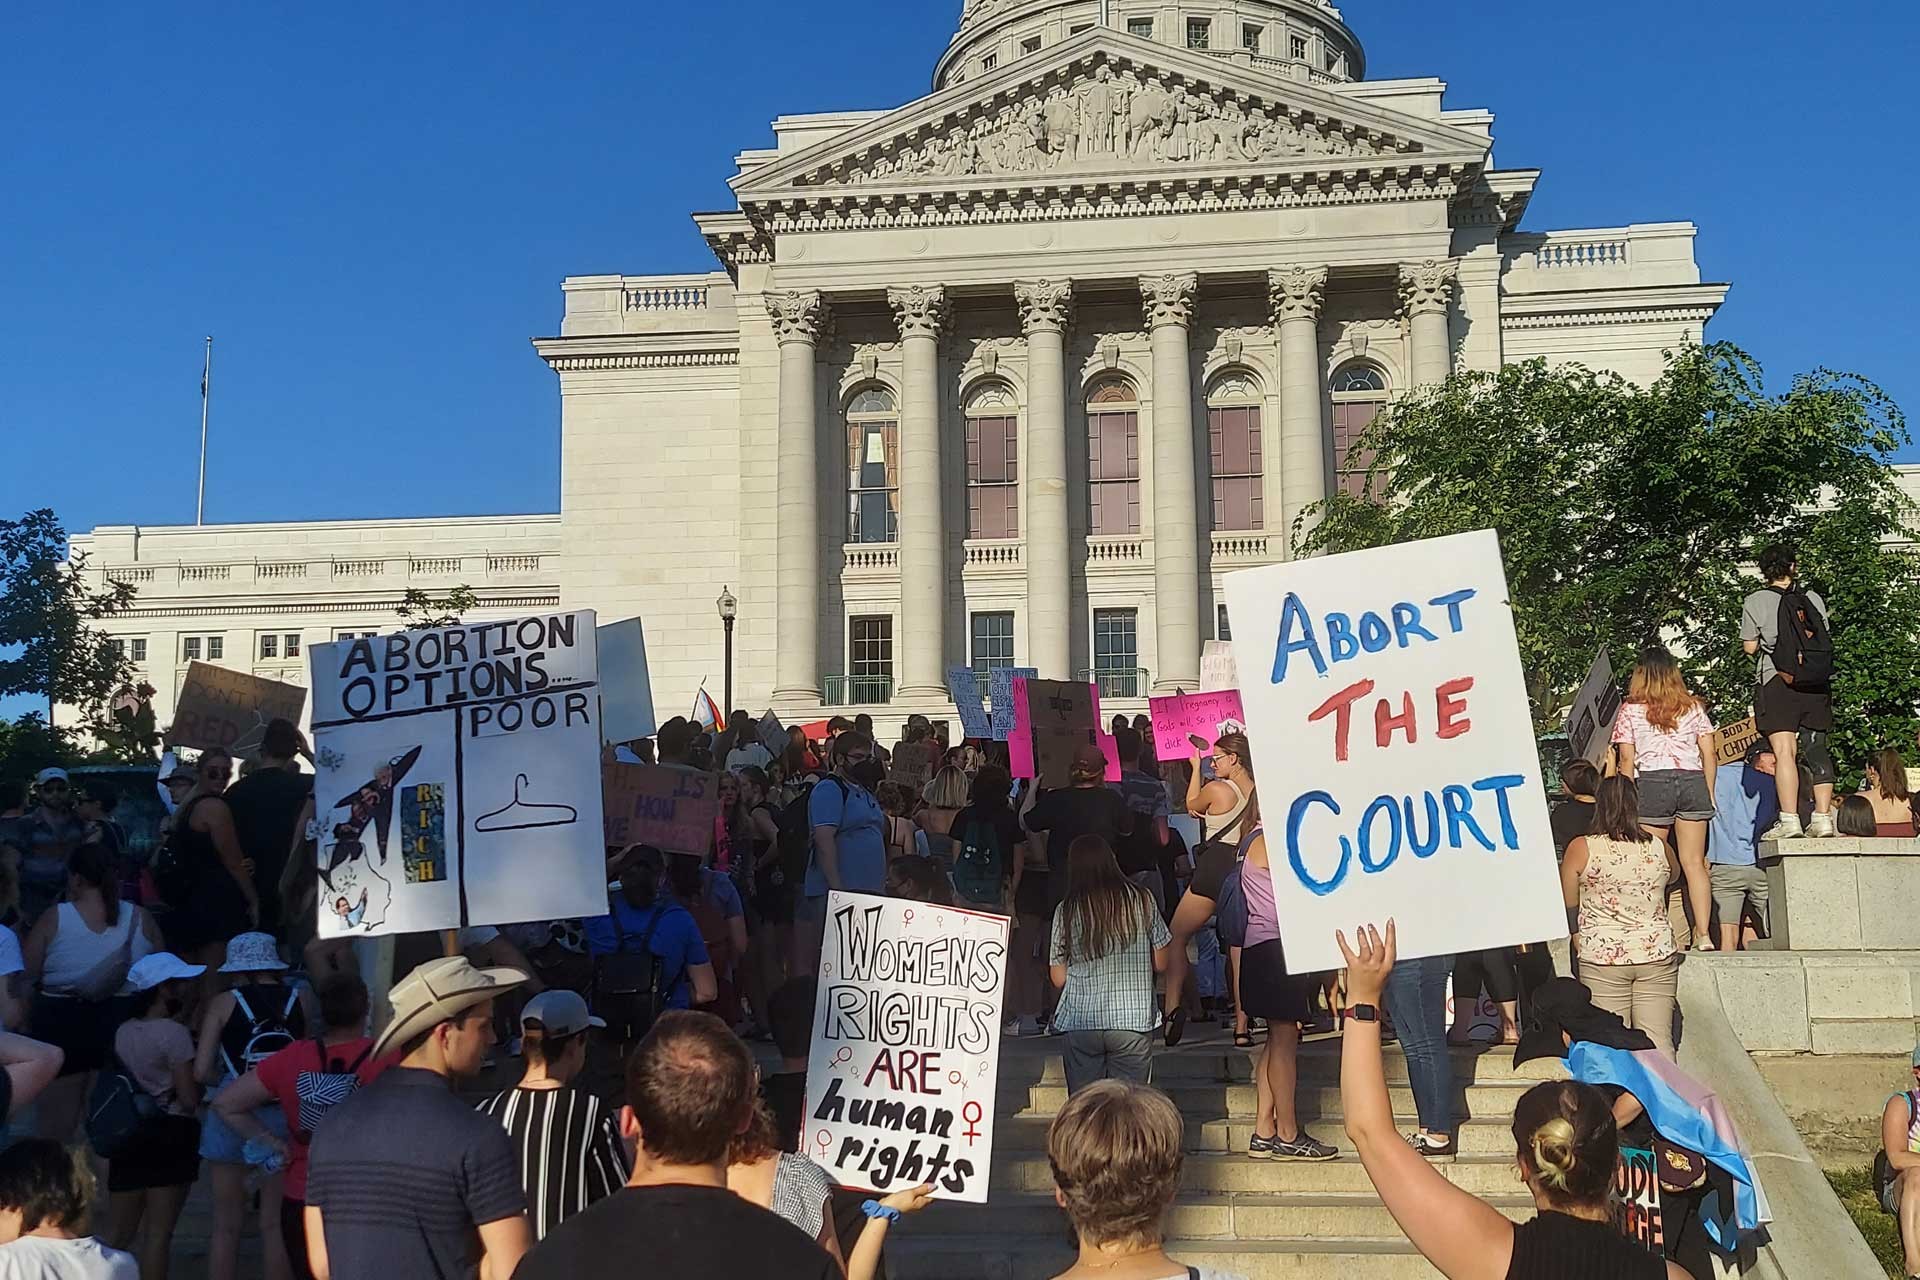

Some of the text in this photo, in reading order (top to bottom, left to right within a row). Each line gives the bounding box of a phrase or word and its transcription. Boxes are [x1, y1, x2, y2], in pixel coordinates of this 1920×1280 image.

[340, 615, 575, 678] ABORTION
[1271, 589, 1477, 684] ABORT
[471, 693, 590, 737] POOR
[1164, 736, 1182, 750] dick
[1308, 677, 1475, 762] THE
[1720, 719, 1751, 739] BODY
[635, 794, 677, 824] HOW
[672, 771, 709, 800] IS
[416, 783, 434, 882] RICH
[1286, 775, 1525, 896] COURT
[834, 904, 1005, 993] WOMENS
[824, 985, 994, 1055] RIGHTS
[863, 1048, 942, 1095] ARE
[813, 1078, 954, 1139] human
[834, 1136, 974, 1193] rights
